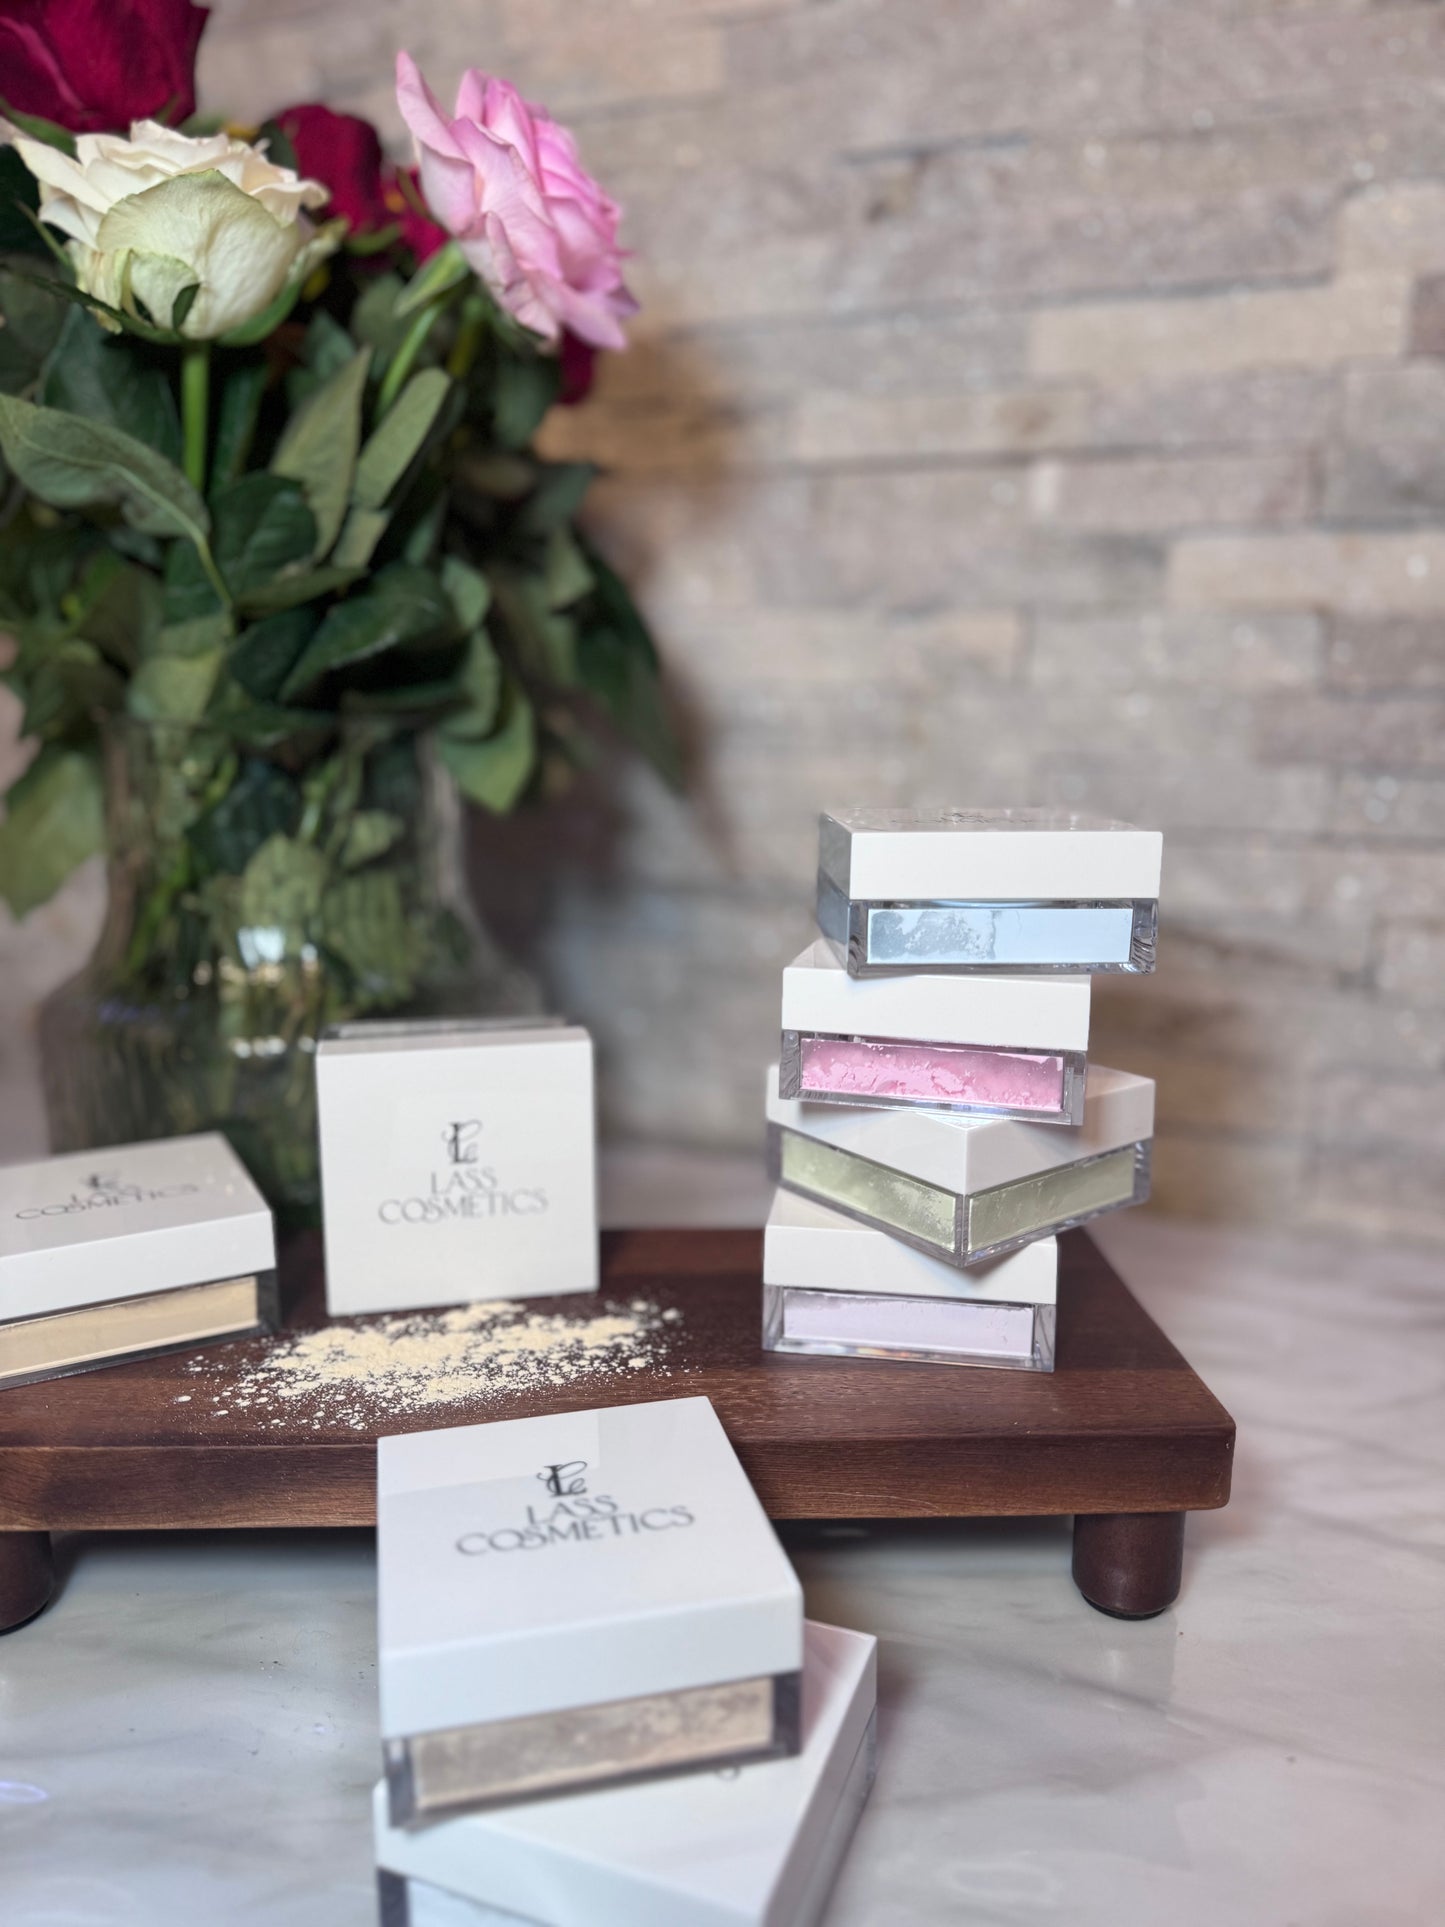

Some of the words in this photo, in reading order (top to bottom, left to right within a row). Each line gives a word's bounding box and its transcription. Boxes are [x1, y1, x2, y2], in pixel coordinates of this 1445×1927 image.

[431, 1167, 498, 1196] LASS
[378, 1189, 550, 1226] COSMETICS
[527, 1494, 619, 1525] LASS
[456, 1505, 696, 1556] COSMETICS
